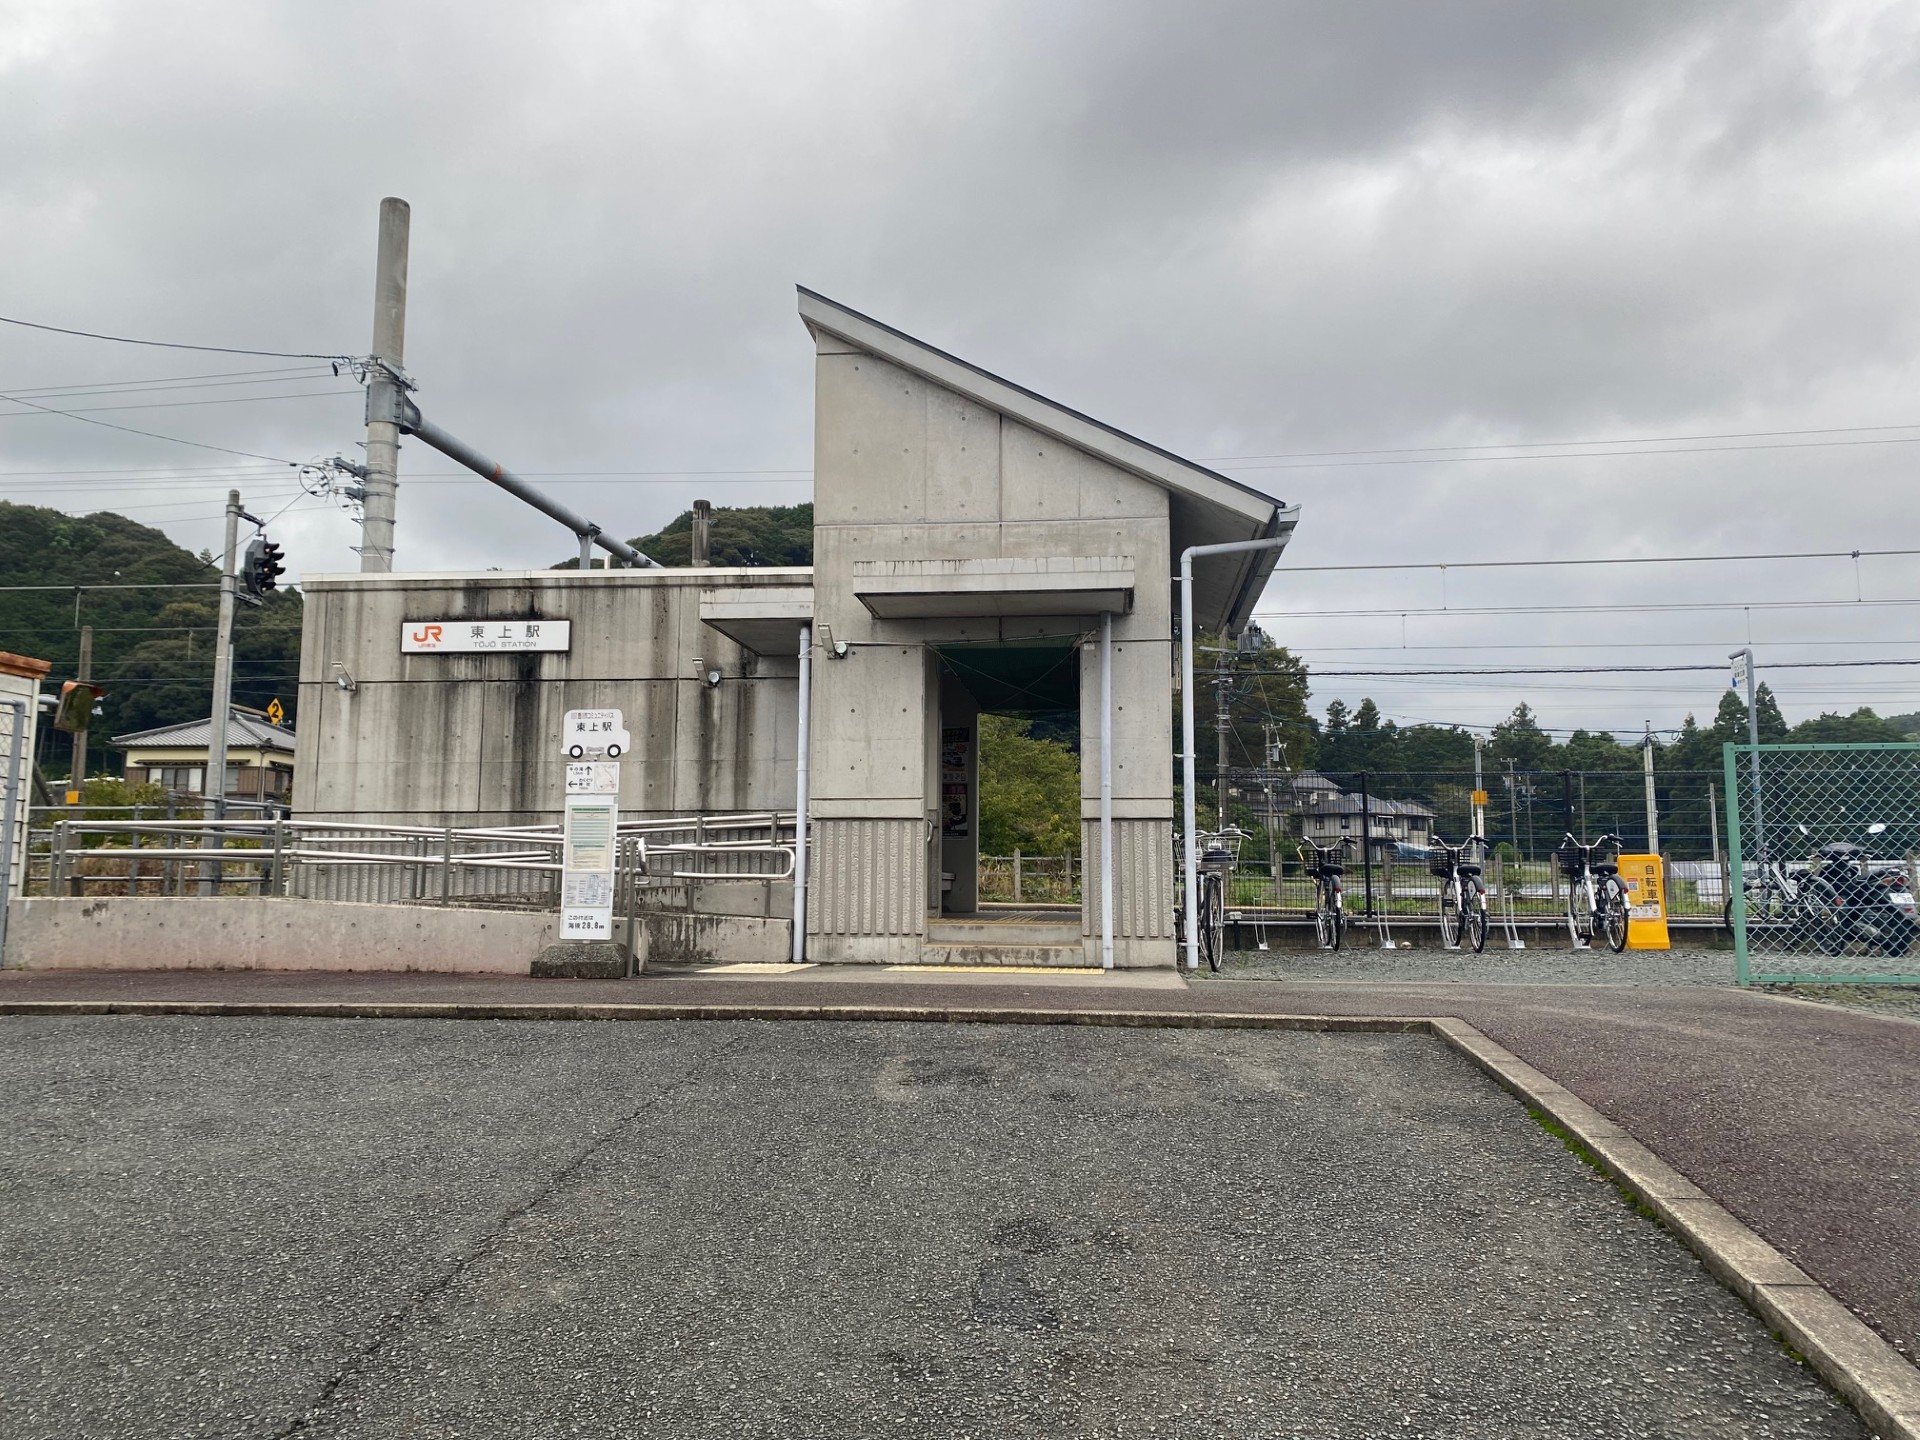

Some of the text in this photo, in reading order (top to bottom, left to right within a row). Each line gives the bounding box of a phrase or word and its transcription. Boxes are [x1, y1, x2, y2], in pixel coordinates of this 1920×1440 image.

[413, 625, 443, 642] JR
[470, 625, 539, 638] 東上駅
[272, 703, 279, 718] 2
[576, 722, 612, 731] 東上駅
[1645, 865, 1657, 899] 自転車
